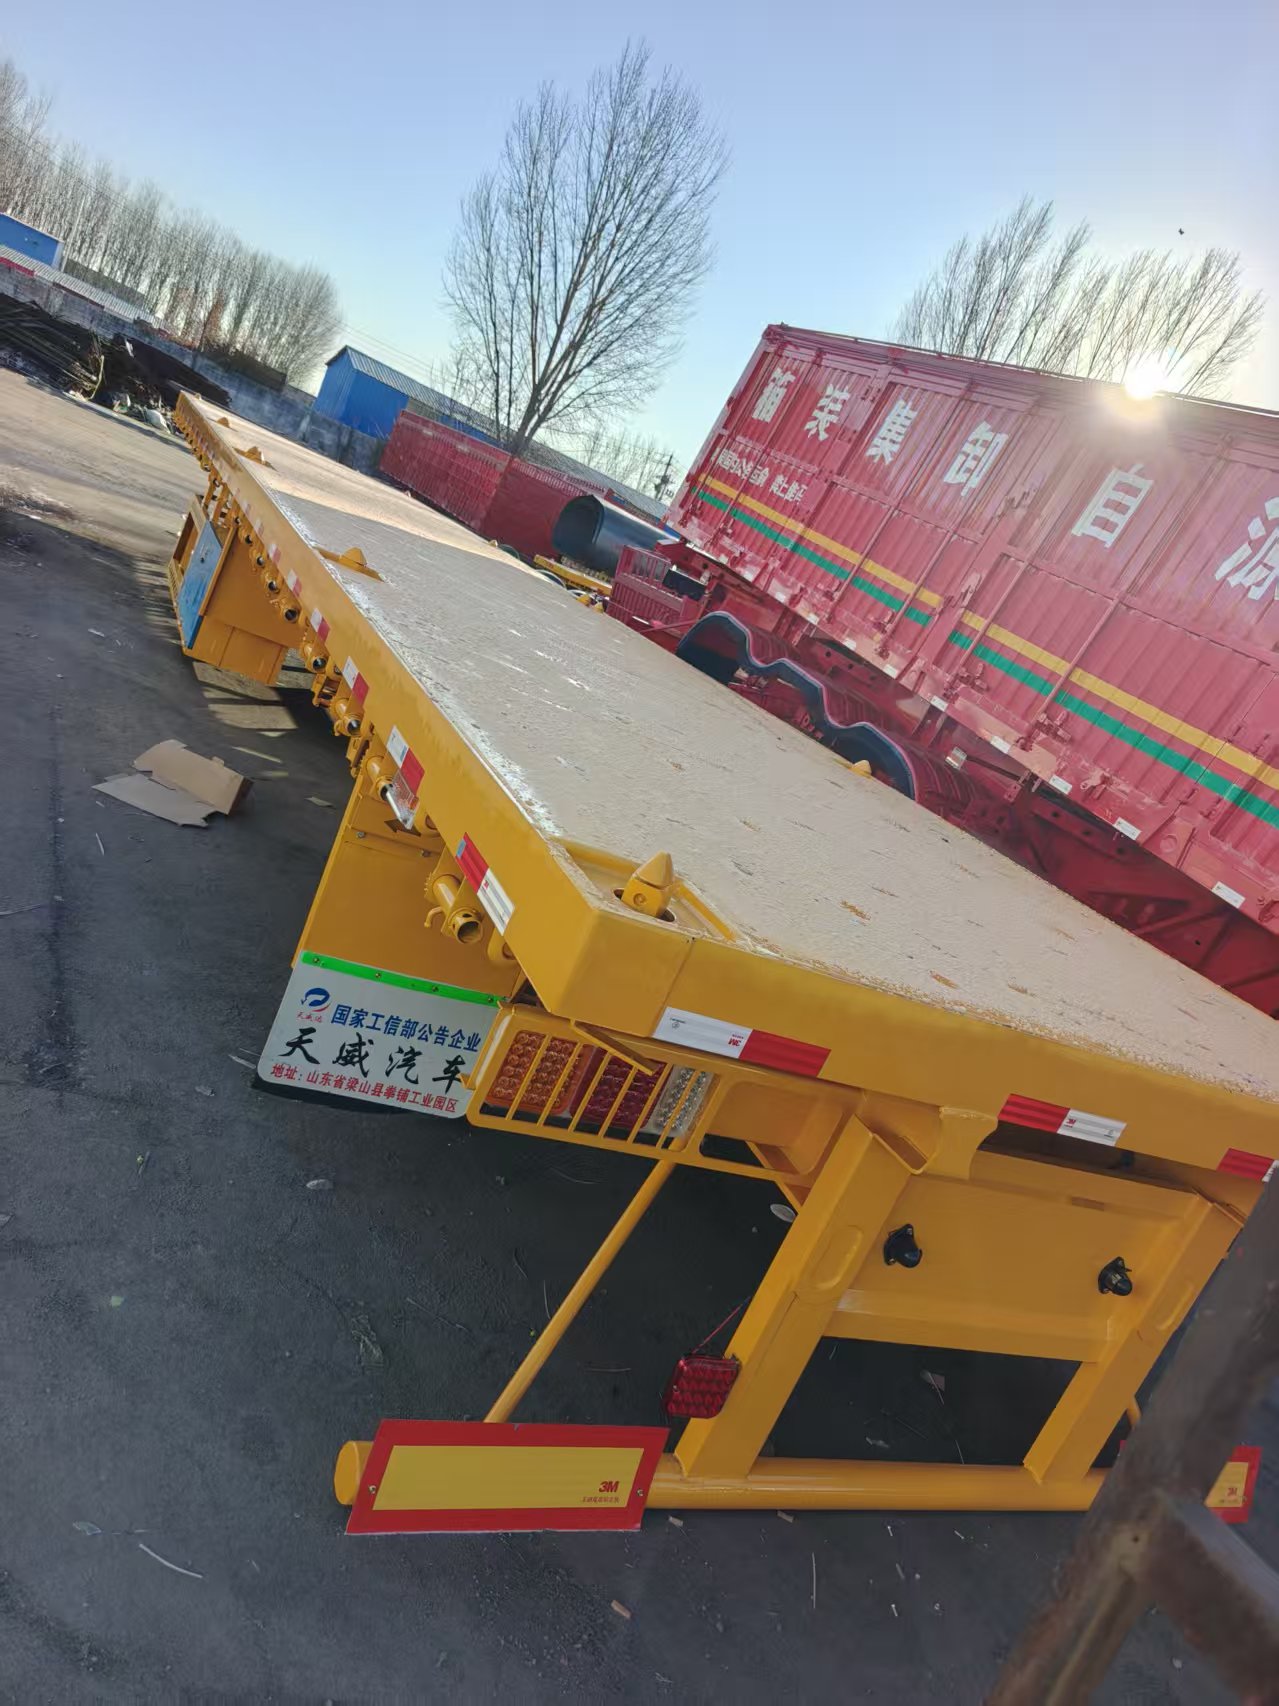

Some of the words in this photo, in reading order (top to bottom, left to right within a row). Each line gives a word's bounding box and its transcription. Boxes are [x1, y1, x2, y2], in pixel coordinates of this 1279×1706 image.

[331, 1004, 482, 1052] 国家工信部公告企业
[279, 1026, 467, 1095] 天威汽车
[599, 1480, 620, 1493] 3M
